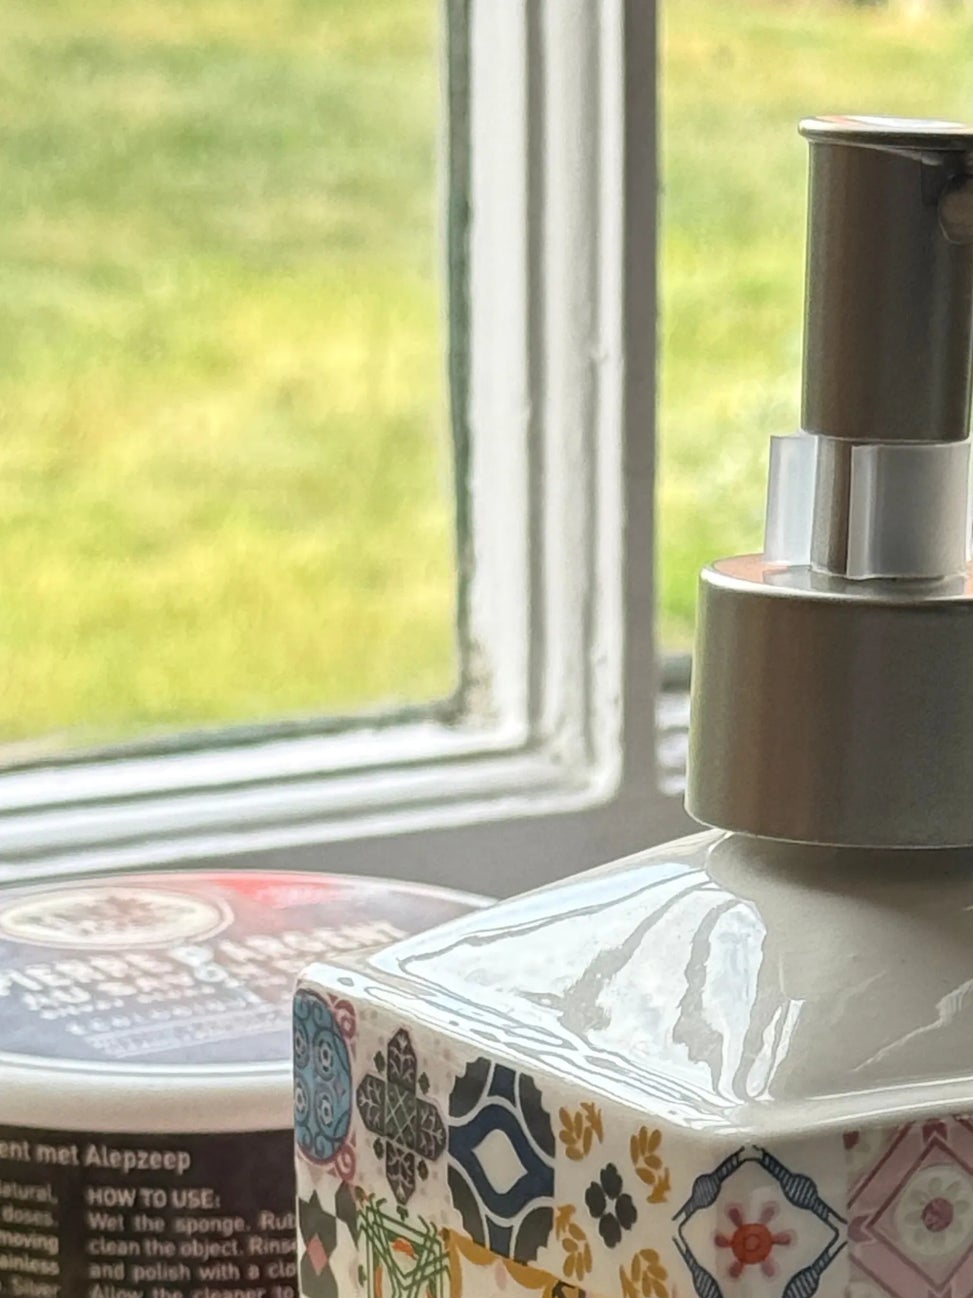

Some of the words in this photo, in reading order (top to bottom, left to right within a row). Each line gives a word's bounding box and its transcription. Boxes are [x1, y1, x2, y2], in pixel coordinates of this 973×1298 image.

[36, 1143, 80, 1167] met
[84, 1143, 192, 1175] Alepzeep
[87, 1185, 137, 1207] HOW
[139, 1187, 168, 1209] TO
[170, 1188, 222, 1210] USE:
[88, 1211, 125, 1232] Wet
[133, 1212, 166, 1233] the
[173, 1214, 252, 1240] sponge.
[88, 1237, 141, 1256] clean
[143, 1237, 177, 1257] the
[179, 1238, 245, 1263] object.
[89, 1260, 126, 1282] and
[132, 1262, 191, 1284] polish
[198, 1261, 241, 1282] with
[246, 1265, 261, 1281] a
